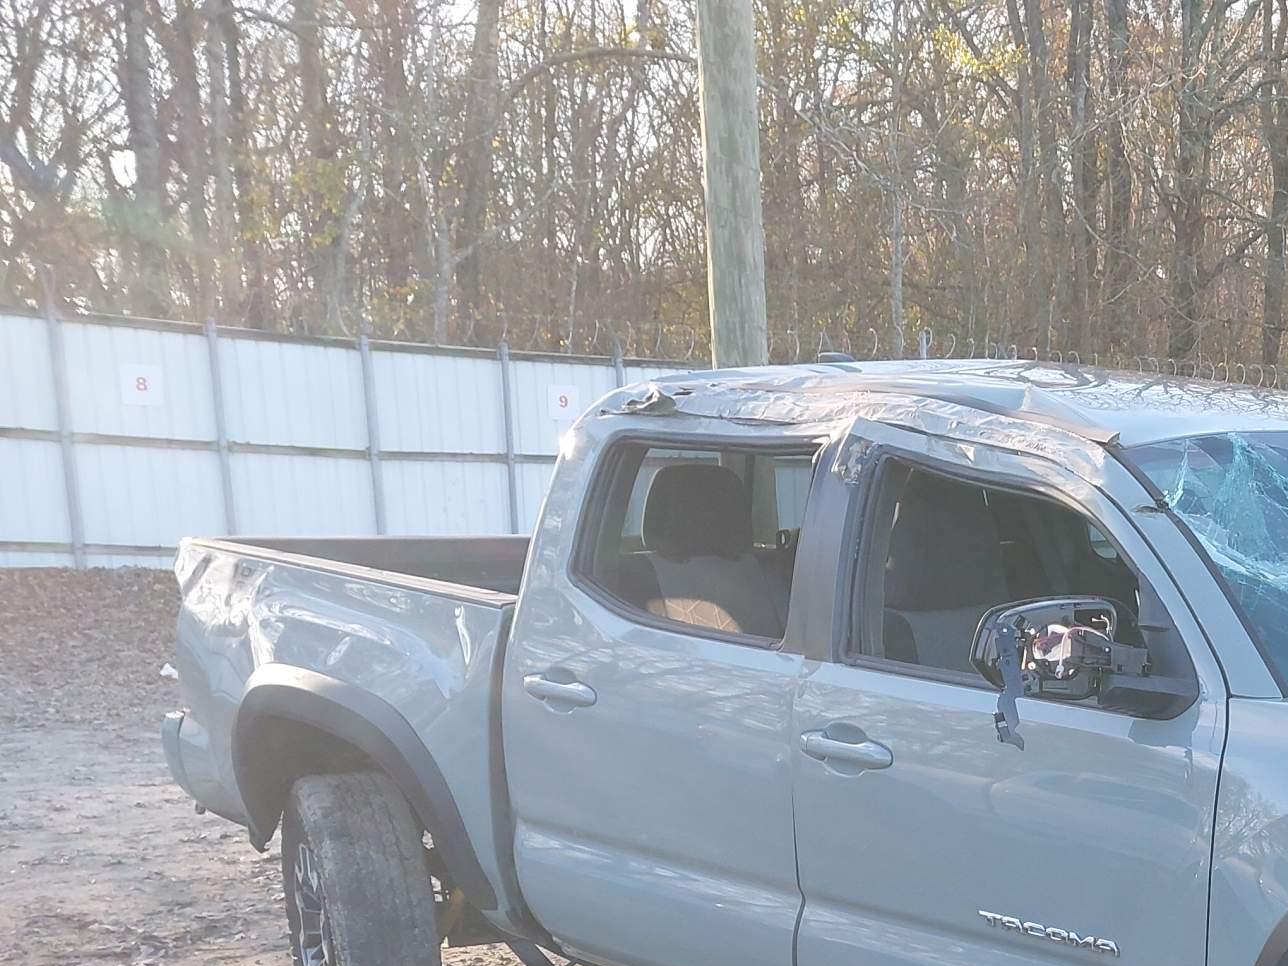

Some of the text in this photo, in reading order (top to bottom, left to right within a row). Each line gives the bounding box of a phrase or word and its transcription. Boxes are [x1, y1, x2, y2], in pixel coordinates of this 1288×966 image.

[135, 376, 148, 391] 8
[559, 395, 569, 408] 9
[977, 909, 1121, 958] TACOMA
